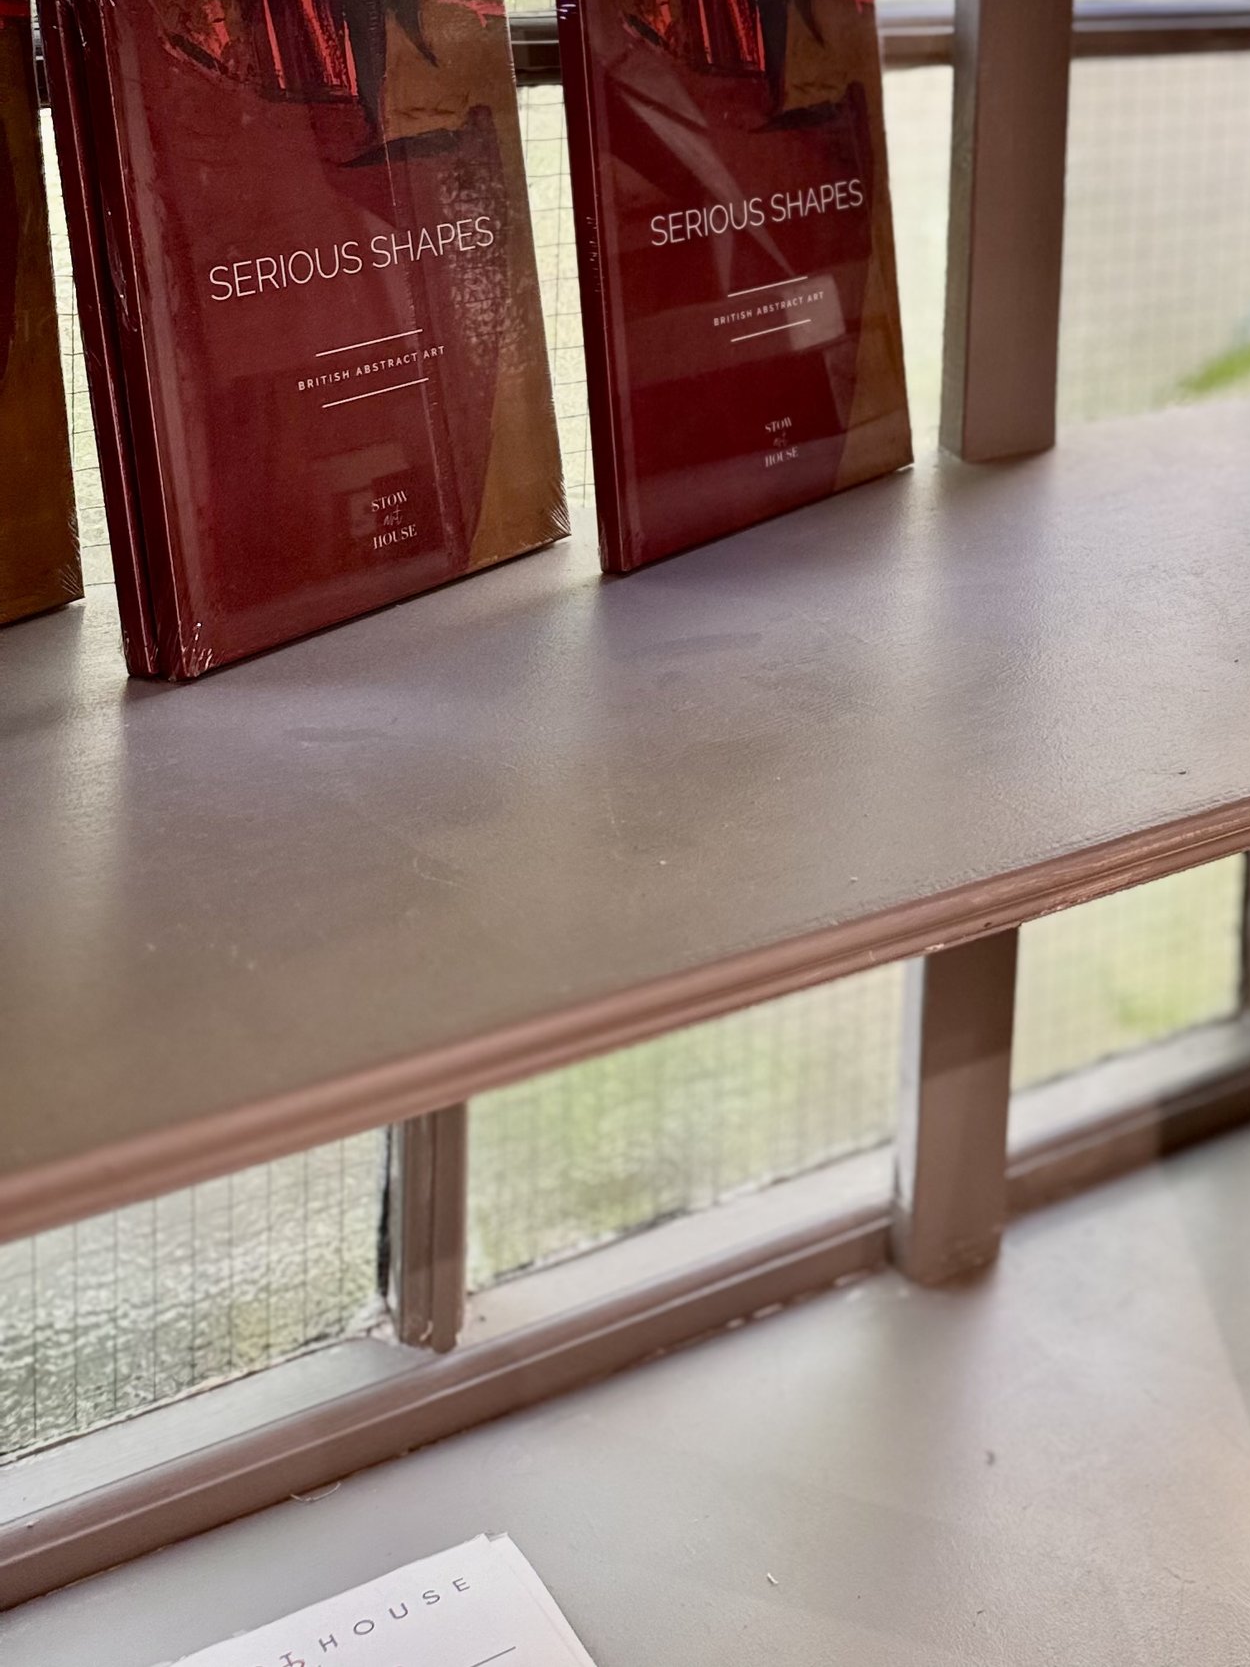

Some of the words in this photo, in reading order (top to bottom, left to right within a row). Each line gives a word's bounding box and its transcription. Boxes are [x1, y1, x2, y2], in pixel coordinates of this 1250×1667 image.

[650, 197, 765, 246] SERIOUS
[770, 179, 863, 222] SHAPES
[209, 241, 363, 301] SERIOUS
[370, 216, 495, 268] SHAPES
[713, 309, 753, 327] BRITISH
[756, 296, 804, 316] ABSTRACT
[807, 291, 825, 303] ART
[297, 369, 351, 391] BRITISH
[355, 352, 418, 376] ABSTRACT
[423, 345, 446, 359] ART
[370, 490, 408, 512] STOW
[372, 523, 418, 550] HOUSE
